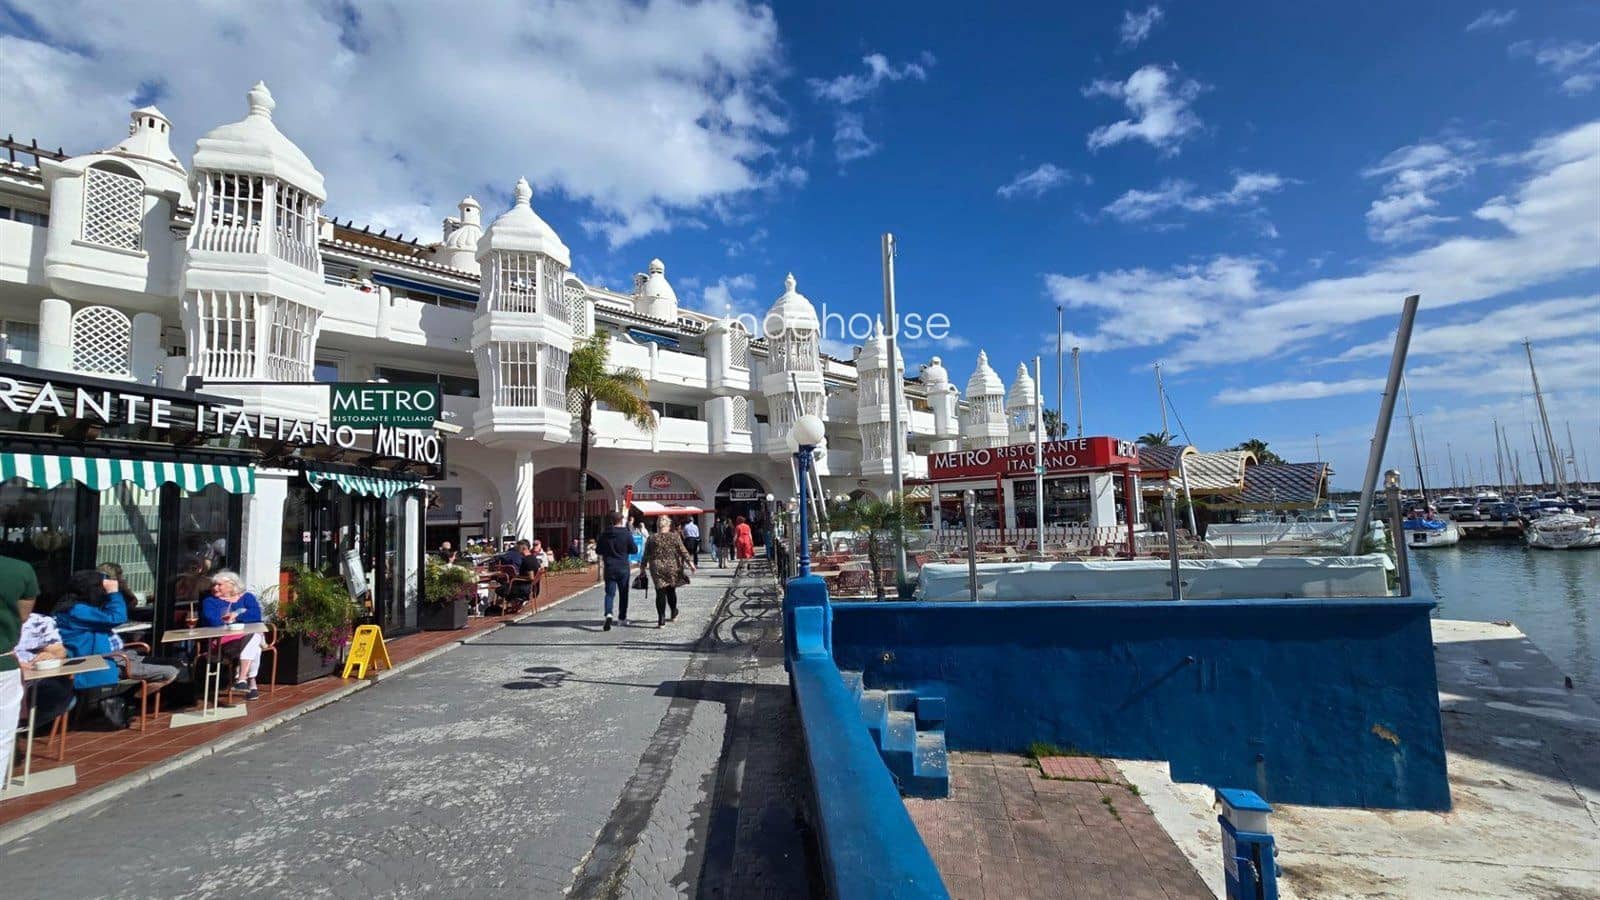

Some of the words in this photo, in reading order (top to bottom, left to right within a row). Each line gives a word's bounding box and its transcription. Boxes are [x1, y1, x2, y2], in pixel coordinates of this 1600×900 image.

[333, 389, 435, 411] METRO
[197, 404, 356, 448] ITALIANO
[376, 423, 439, 464] METRO
[934, 448, 991, 469] METRO
[1007, 454, 1077, 472] ITALANO
